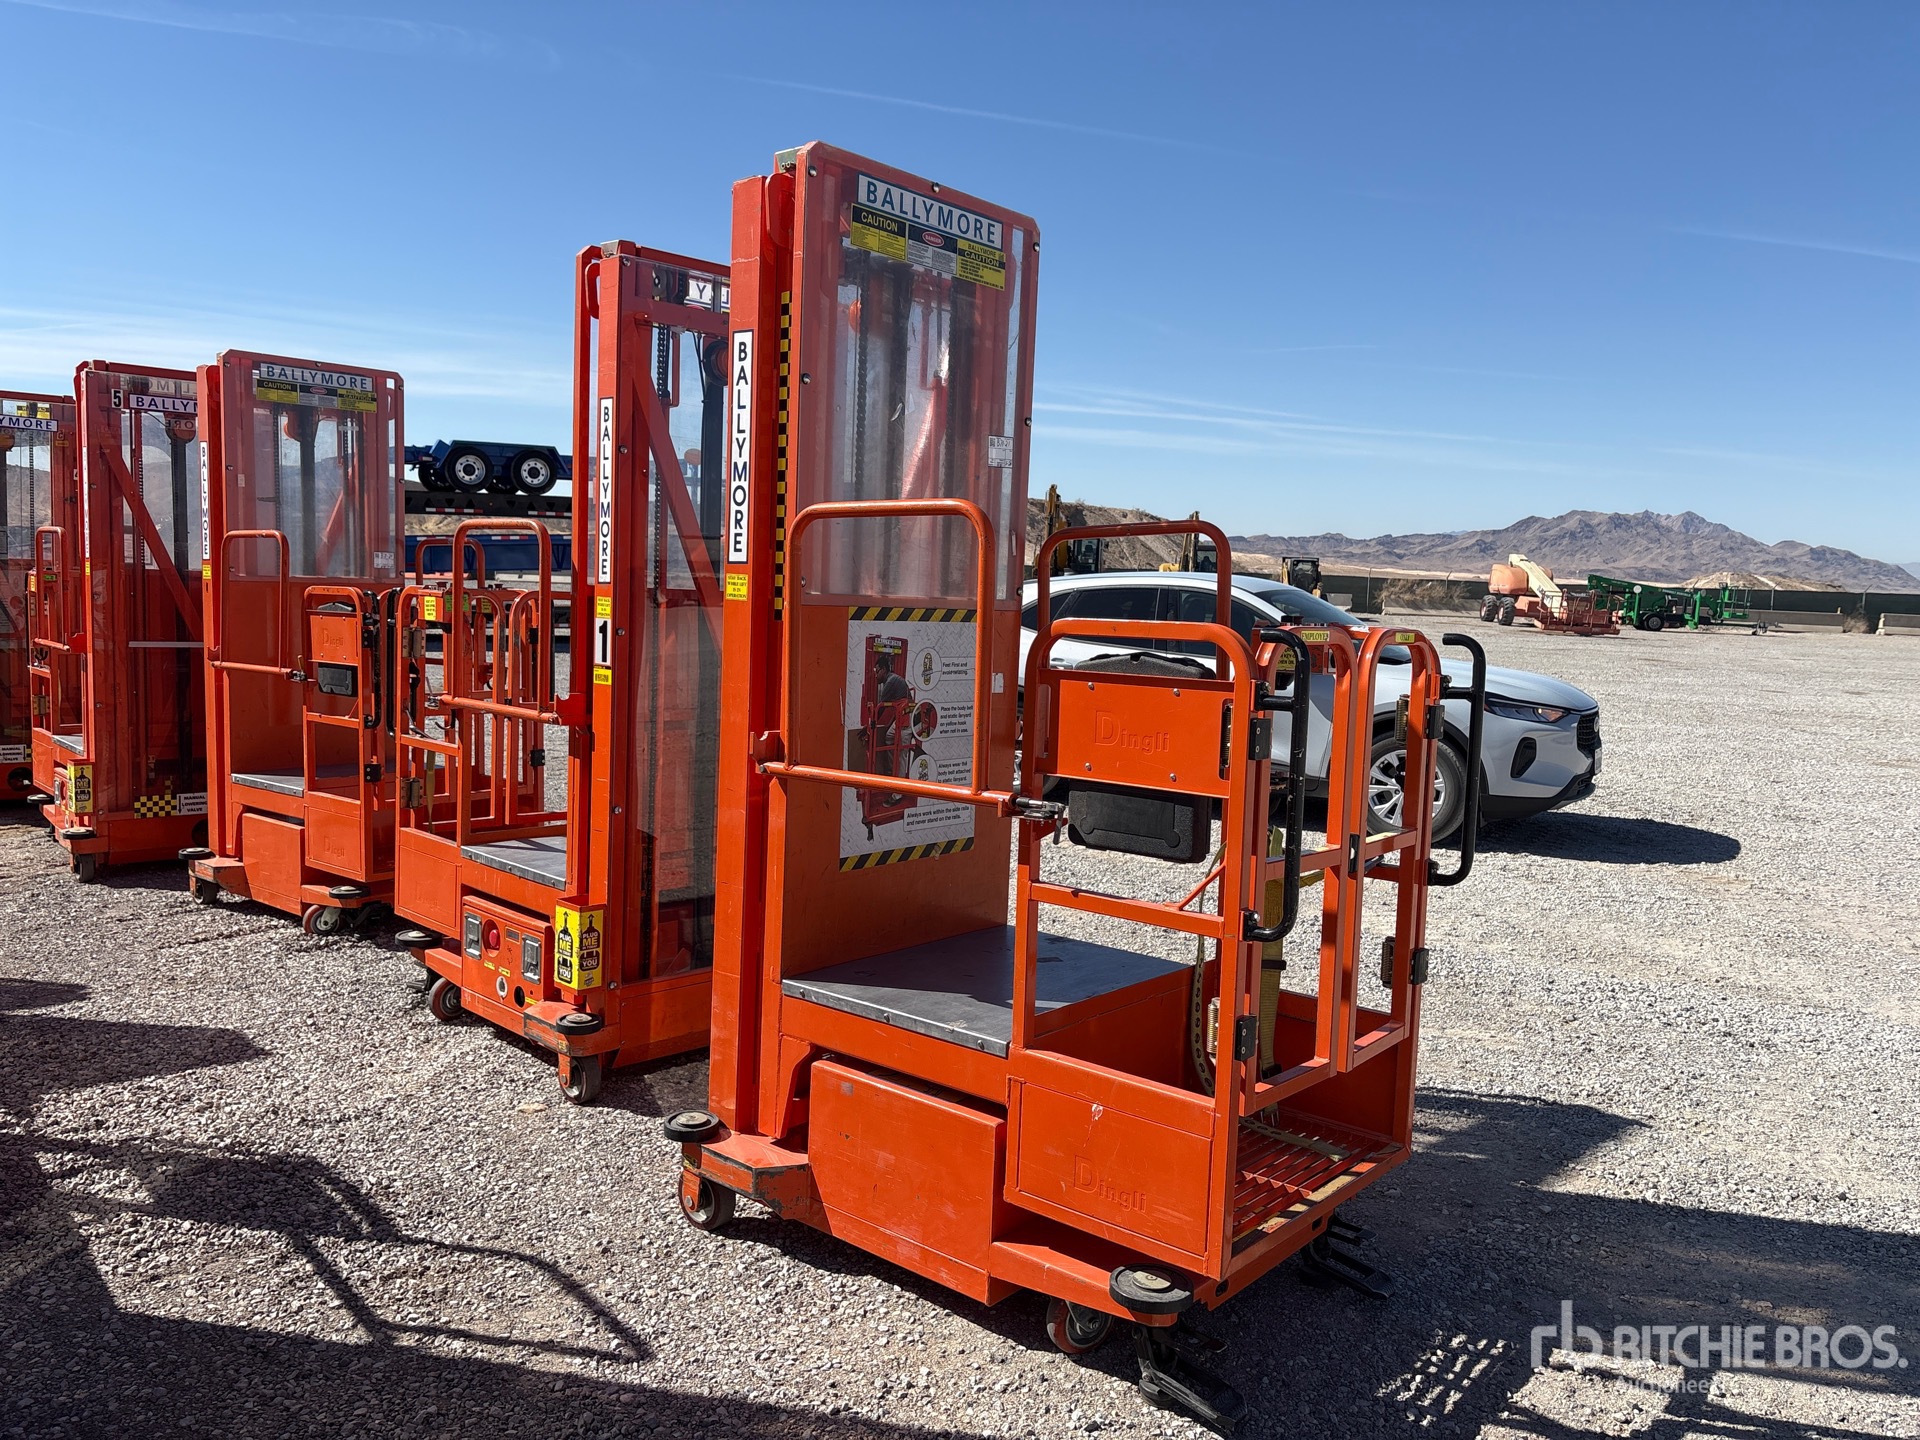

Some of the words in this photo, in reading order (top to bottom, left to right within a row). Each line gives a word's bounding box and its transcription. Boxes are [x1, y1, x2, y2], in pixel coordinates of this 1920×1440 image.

[866, 180, 996, 244] BALLYMORE
[861, 212, 898, 233] CAUTION
[964, 250, 999, 267] CAUTION
[967, 244, 997, 257] BALLYMORE
[263, 381, 292, 391] CAUTION
[266, 365, 368, 389] BALLYMORE
[113, 390, 122, 408] 5
[732, 341, 748, 553] BALLYMORE
[600, 406, 610, 575] BALLYMORE
[599, 620, 608, 663] 1
[1094, 710, 1170, 756] Dingli
[560, 940, 571, 952] ME
[583, 937, 598, 947] ME
[582, 959, 598, 967] YOU
[559, 969, 571, 978] YOU
[1073, 1154, 1147, 1212] Dingli
